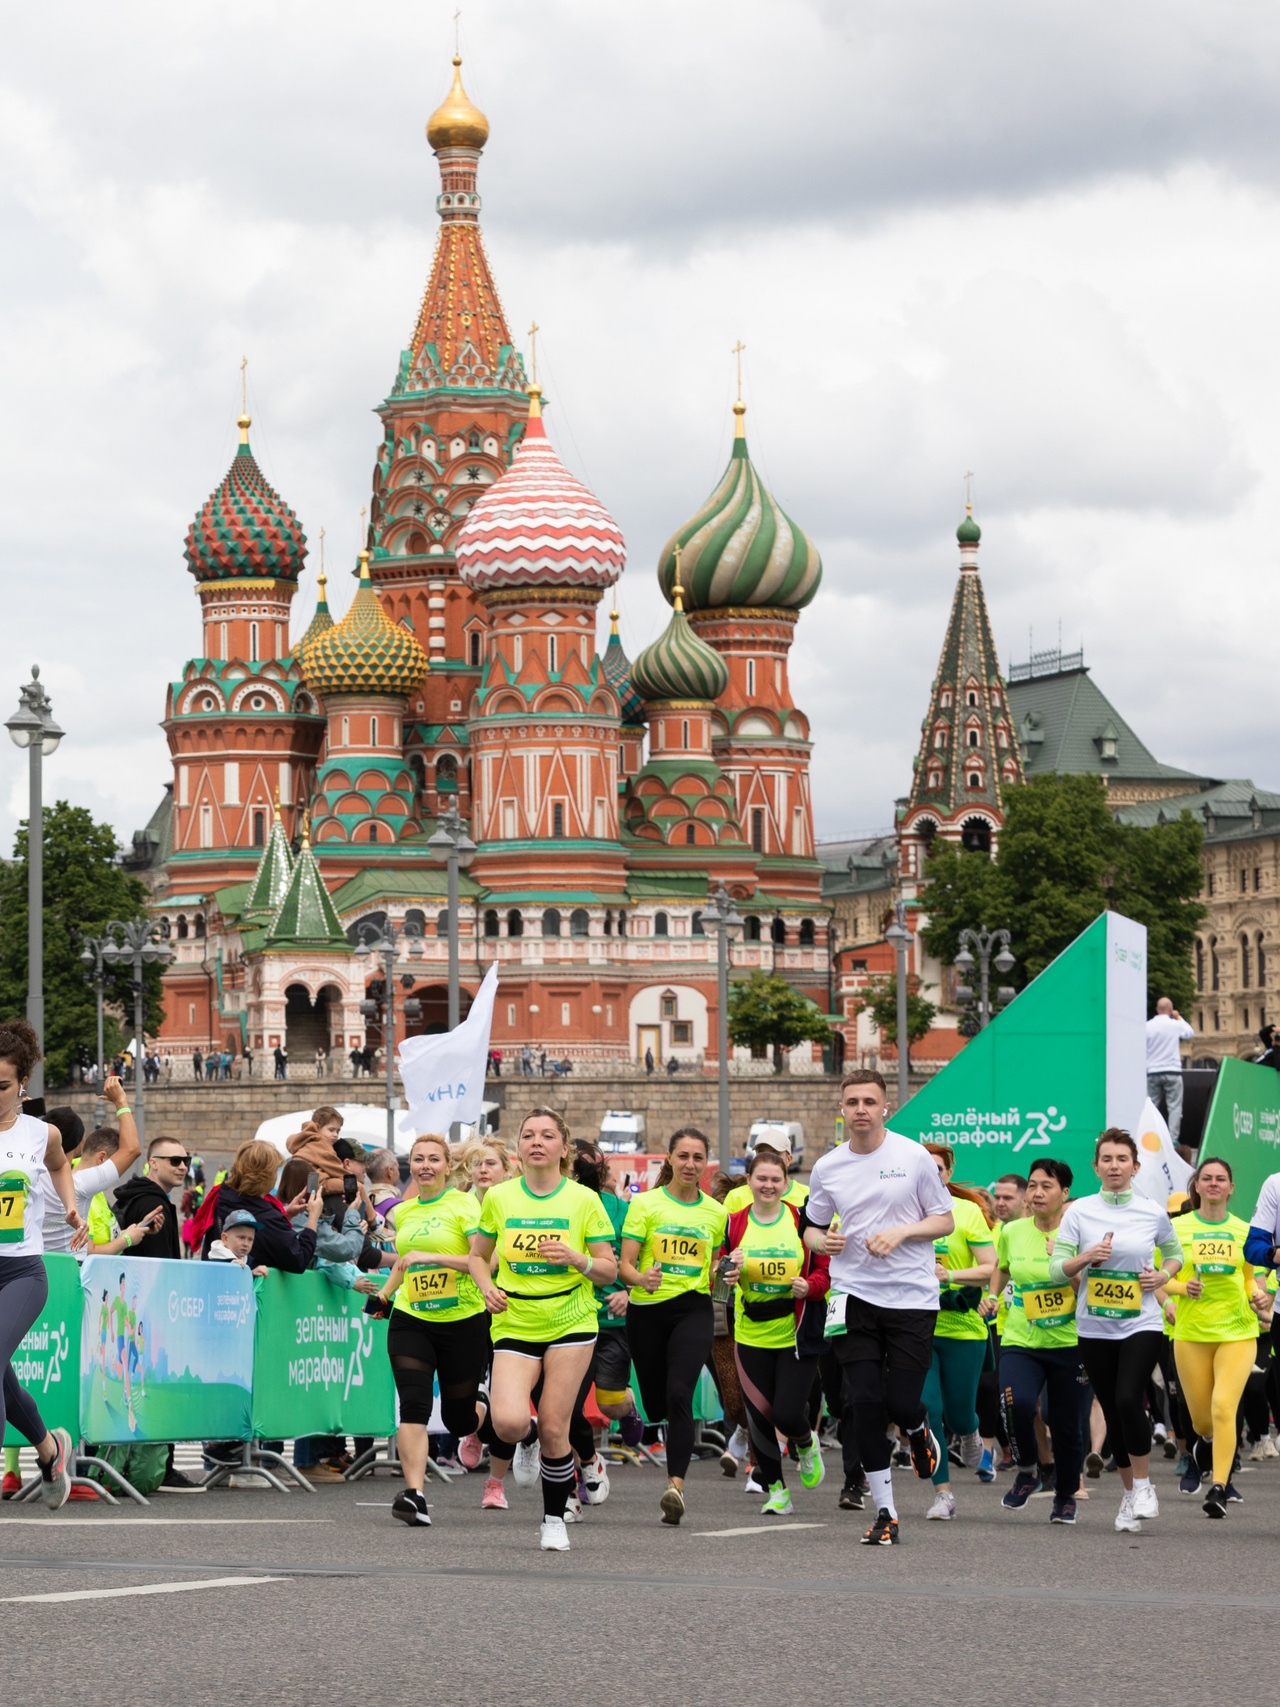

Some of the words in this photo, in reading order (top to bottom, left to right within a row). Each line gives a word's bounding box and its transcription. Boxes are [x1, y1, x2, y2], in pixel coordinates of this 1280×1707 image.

[931, 1107, 1021, 1127] зелёный
[919, 1126, 1013, 1148] марафон
[661, 1238, 698, 1257] 1104
[1199, 1243, 1232, 1257] 2341
[759, 1262, 786, 1276] 105
[412, 1272, 448, 1292] 1547
[1094, 1282, 1135, 1301] 2434
[180, 1296, 205, 1318] СБЕР
[1034, 1291, 1064, 1309] 158
[296, 1304, 349, 1344] зелёный
[288, 1345, 345, 1392] марафон
